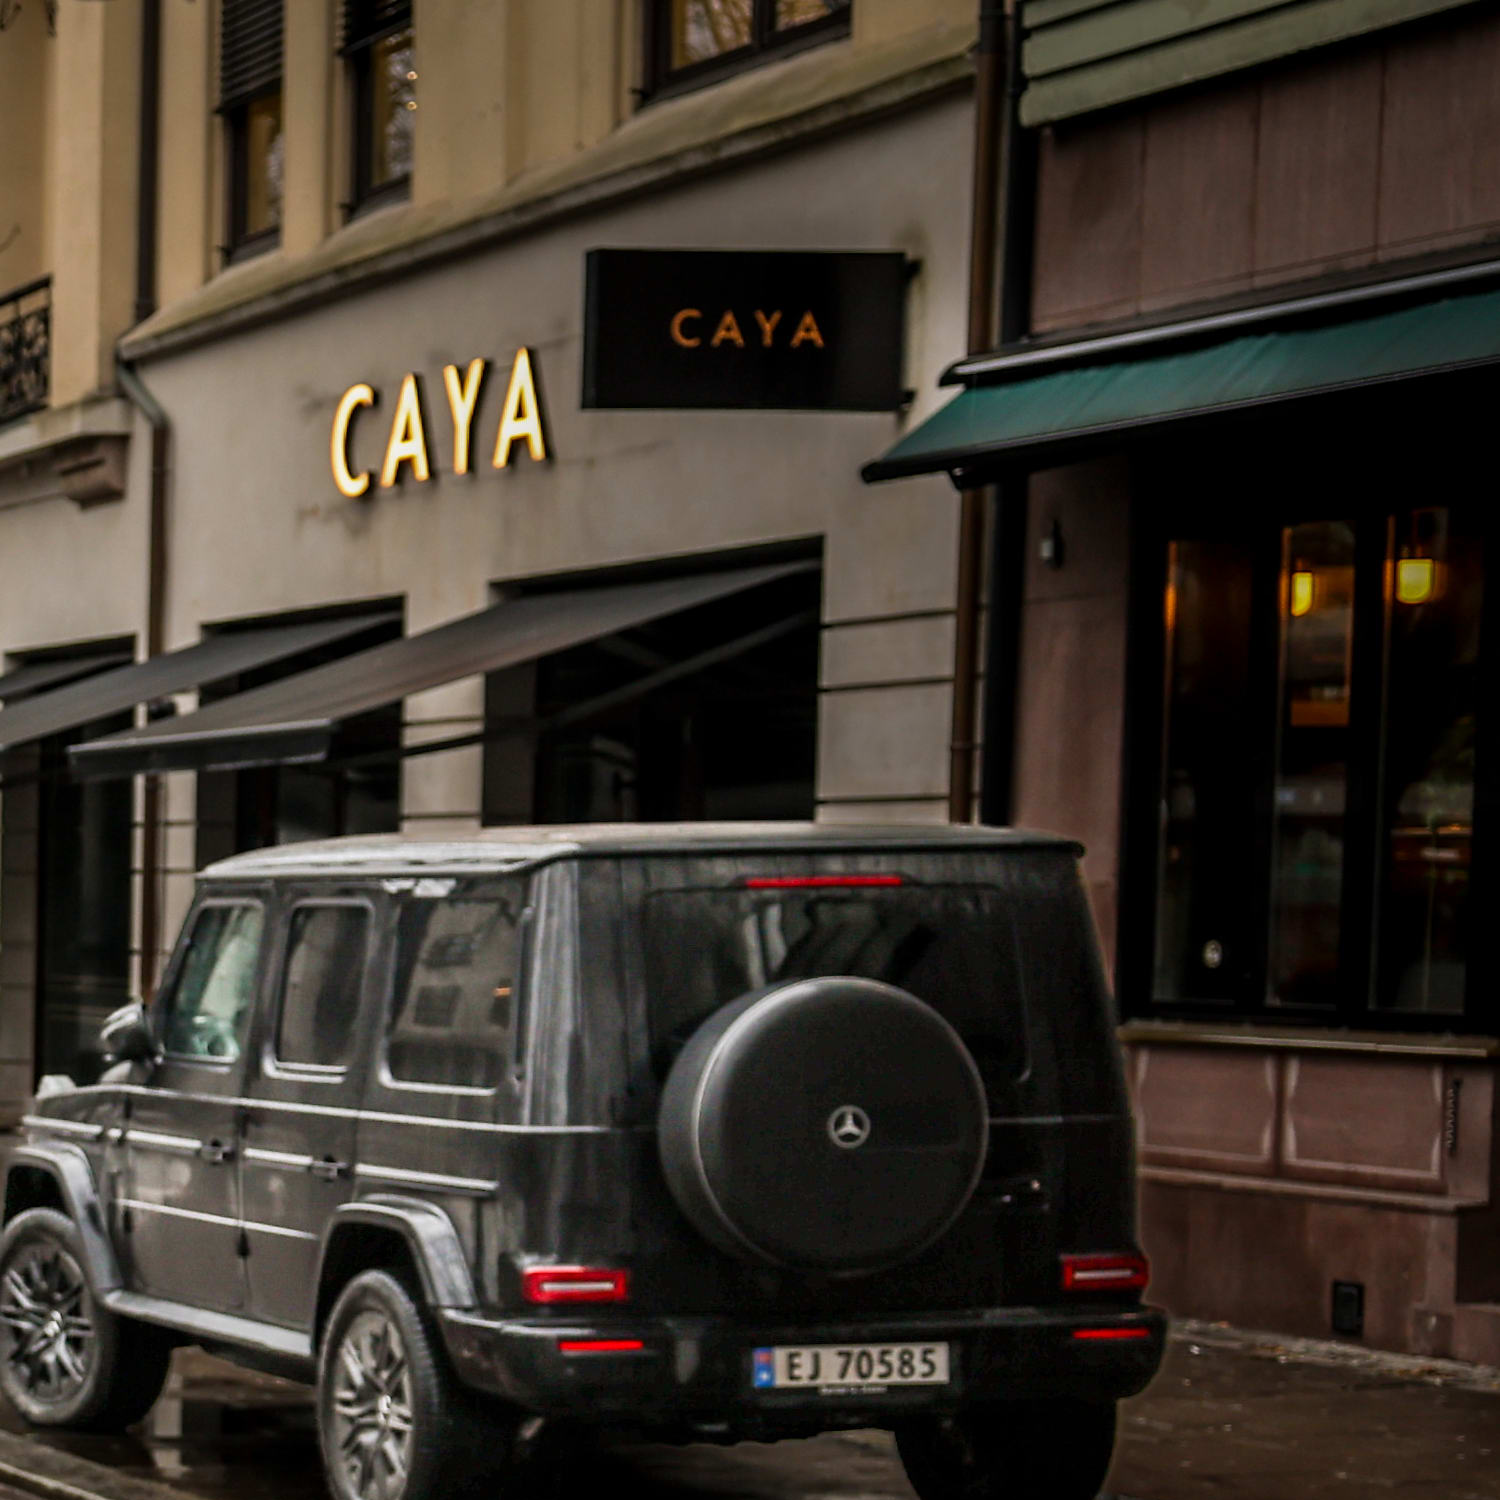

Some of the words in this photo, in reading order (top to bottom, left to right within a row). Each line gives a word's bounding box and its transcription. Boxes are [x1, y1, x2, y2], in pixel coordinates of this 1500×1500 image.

[670, 308, 824, 348] CAYA
[330, 346, 546, 498] CAYA
[786, 1352, 821, 1381] EJ
[836, 1348, 936, 1379] 70585
